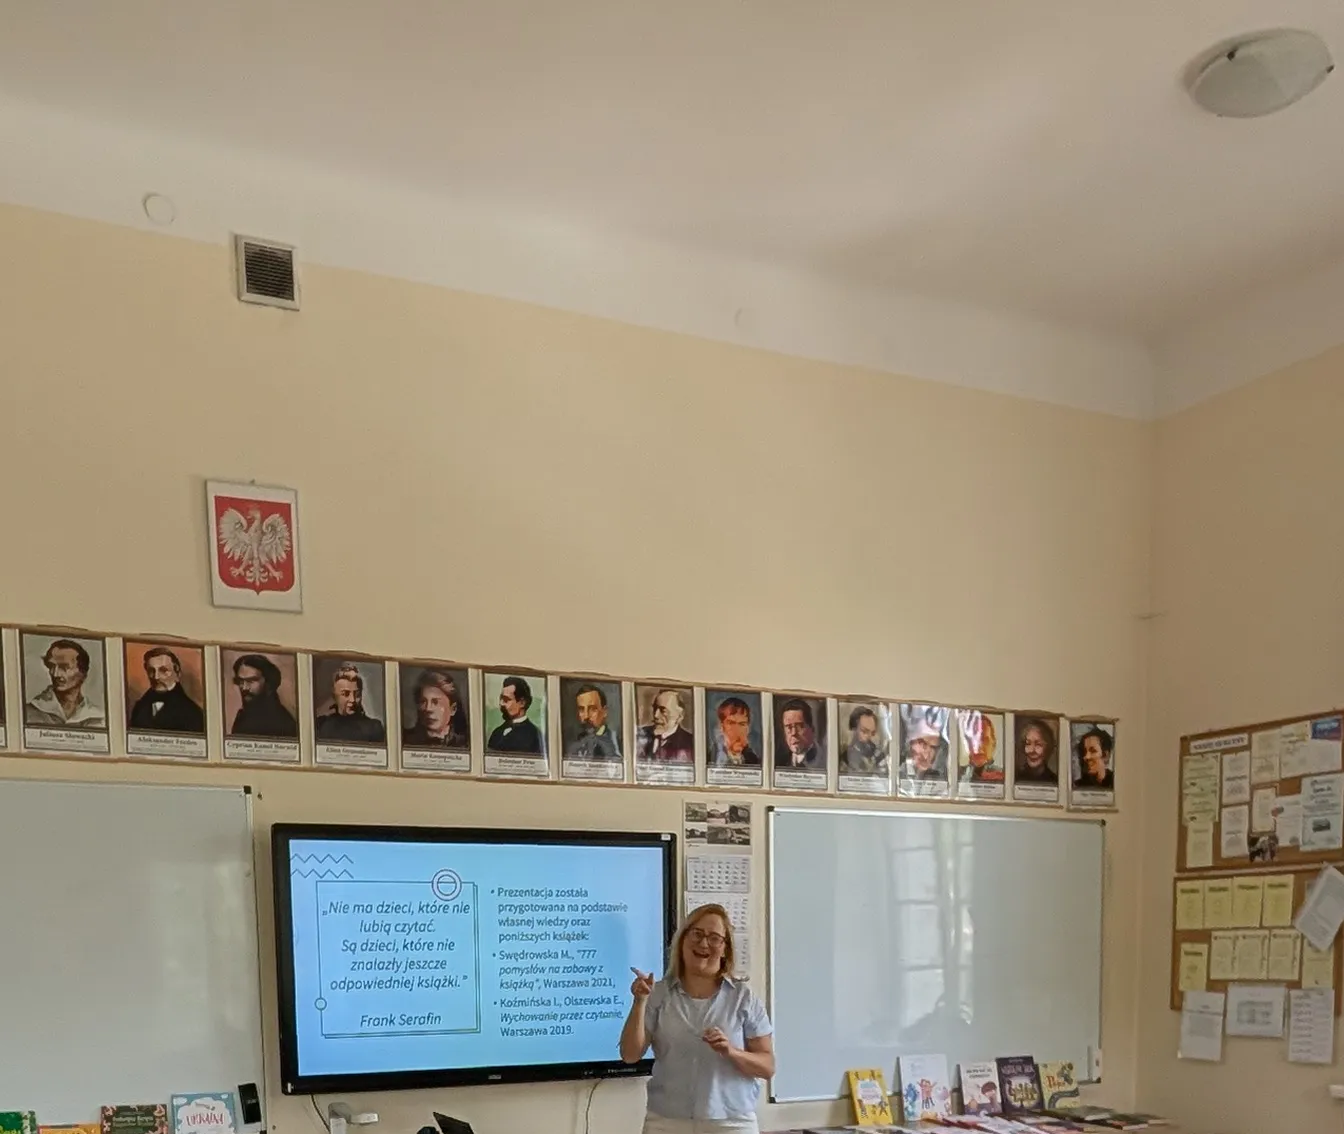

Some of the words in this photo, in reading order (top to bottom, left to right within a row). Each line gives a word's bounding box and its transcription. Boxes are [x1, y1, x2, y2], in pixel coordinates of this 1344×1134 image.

[497, 887, 553, 899] Prezentacja
[555, 887, 588, 898] została
[352, 903, 373, 914] ma
[376, 900, 414, 915] dzieci,
[418, 900, 449, 914] które
[452, 901, 470, 914] nie
[498, 903, 565, 914] przygotowana
[567, 904, 579, 912] na
[581, 902, 628, 914] podstawie
[359, 920, 392, 935] lubią
[536, 916, 570, 929] wiedzy
[571, 918, 591, 927] oraz
[341, 939, 357, 955] Są
[360, 938, 399, 953] dzieci,
[402, 938, 435, 951] które
[436, 938, 455, 951] nie
[350, 957, 403, 973] znalazły
[403, 959, 447, 973] jeszcze
[548, 966, 562, 974] na
[597, 965, 604, 973] z
[330, 975, 415, 992] odpowiedniej
[543, 979, 590, 989] Warszawa
[360, 1012, 396, 1027] Frank
[398, 1012, 442, 1026] Serafin
[500, 1027, 548, 1037] Warszawa
